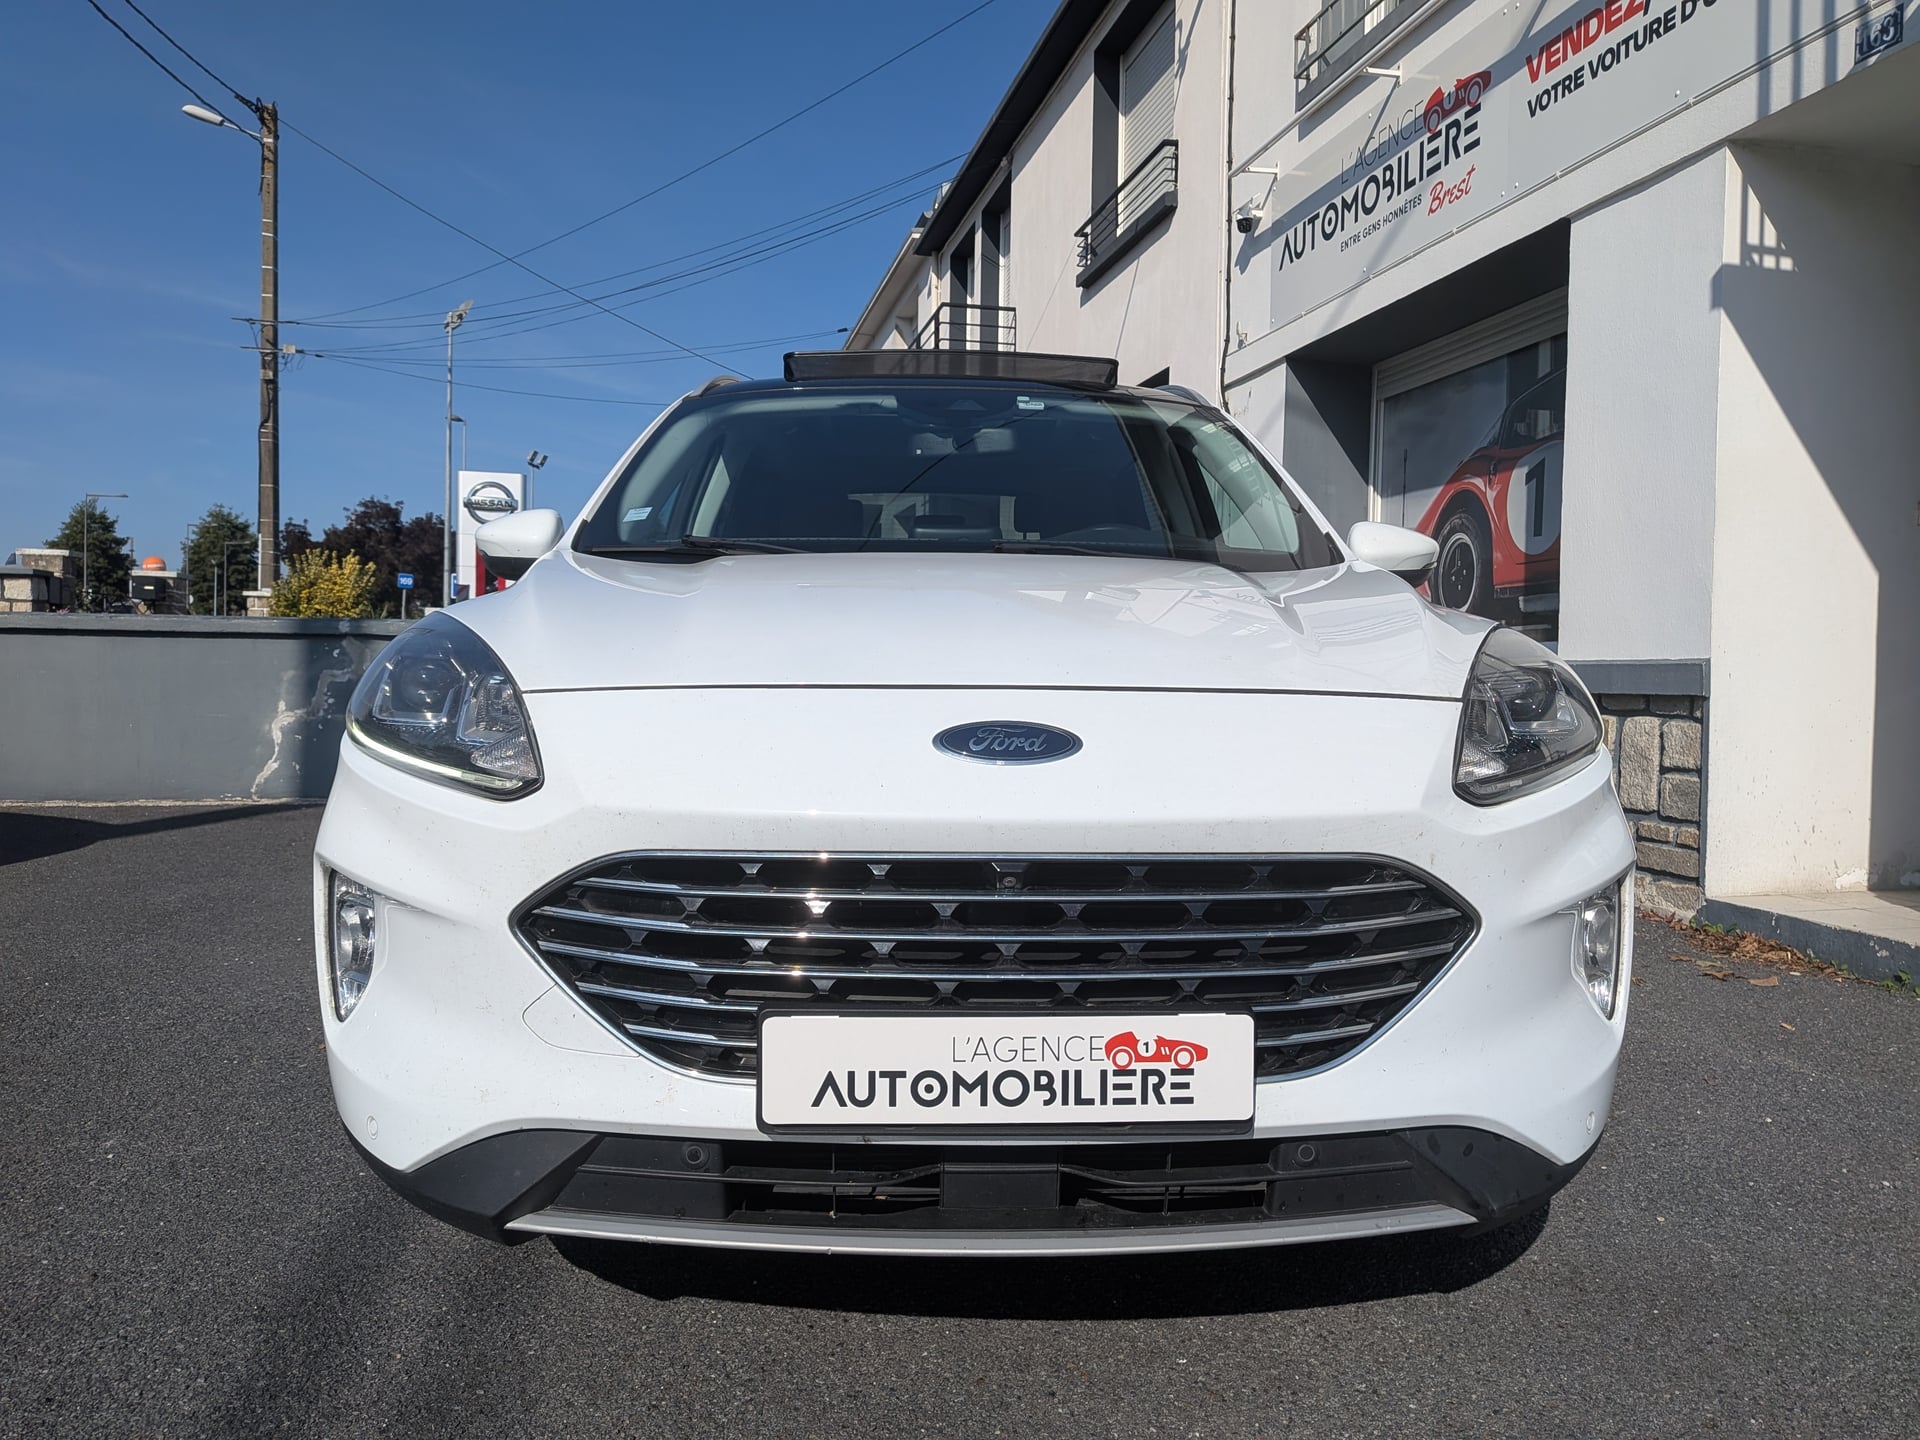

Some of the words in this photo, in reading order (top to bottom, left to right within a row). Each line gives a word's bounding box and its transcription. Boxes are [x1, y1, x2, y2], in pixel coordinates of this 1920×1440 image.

[1863, 16, 1895, 52] 163
[1527, 65, 1585, 118] VOTRE
[1588, 5, 1677, 80] VOITURE
[1340, 99, 1424, 185] L'AGENCE
[1427, 164, 1476, 216] Brest
[1340, 231, 1361, 252] ENTRE
[1362, 219, 1381, 240] GENS
[1382, 194, 1422, 228] HONNÊTES
[466, 498, 514, 508] NISSAN
[1525, 456, 1546, 537] 1
[968, 727, 1048, 752] Ford
[952, 1034, 1105, 1063] L'AGENCE
[1142, 1041, 1150, 1054] 1
